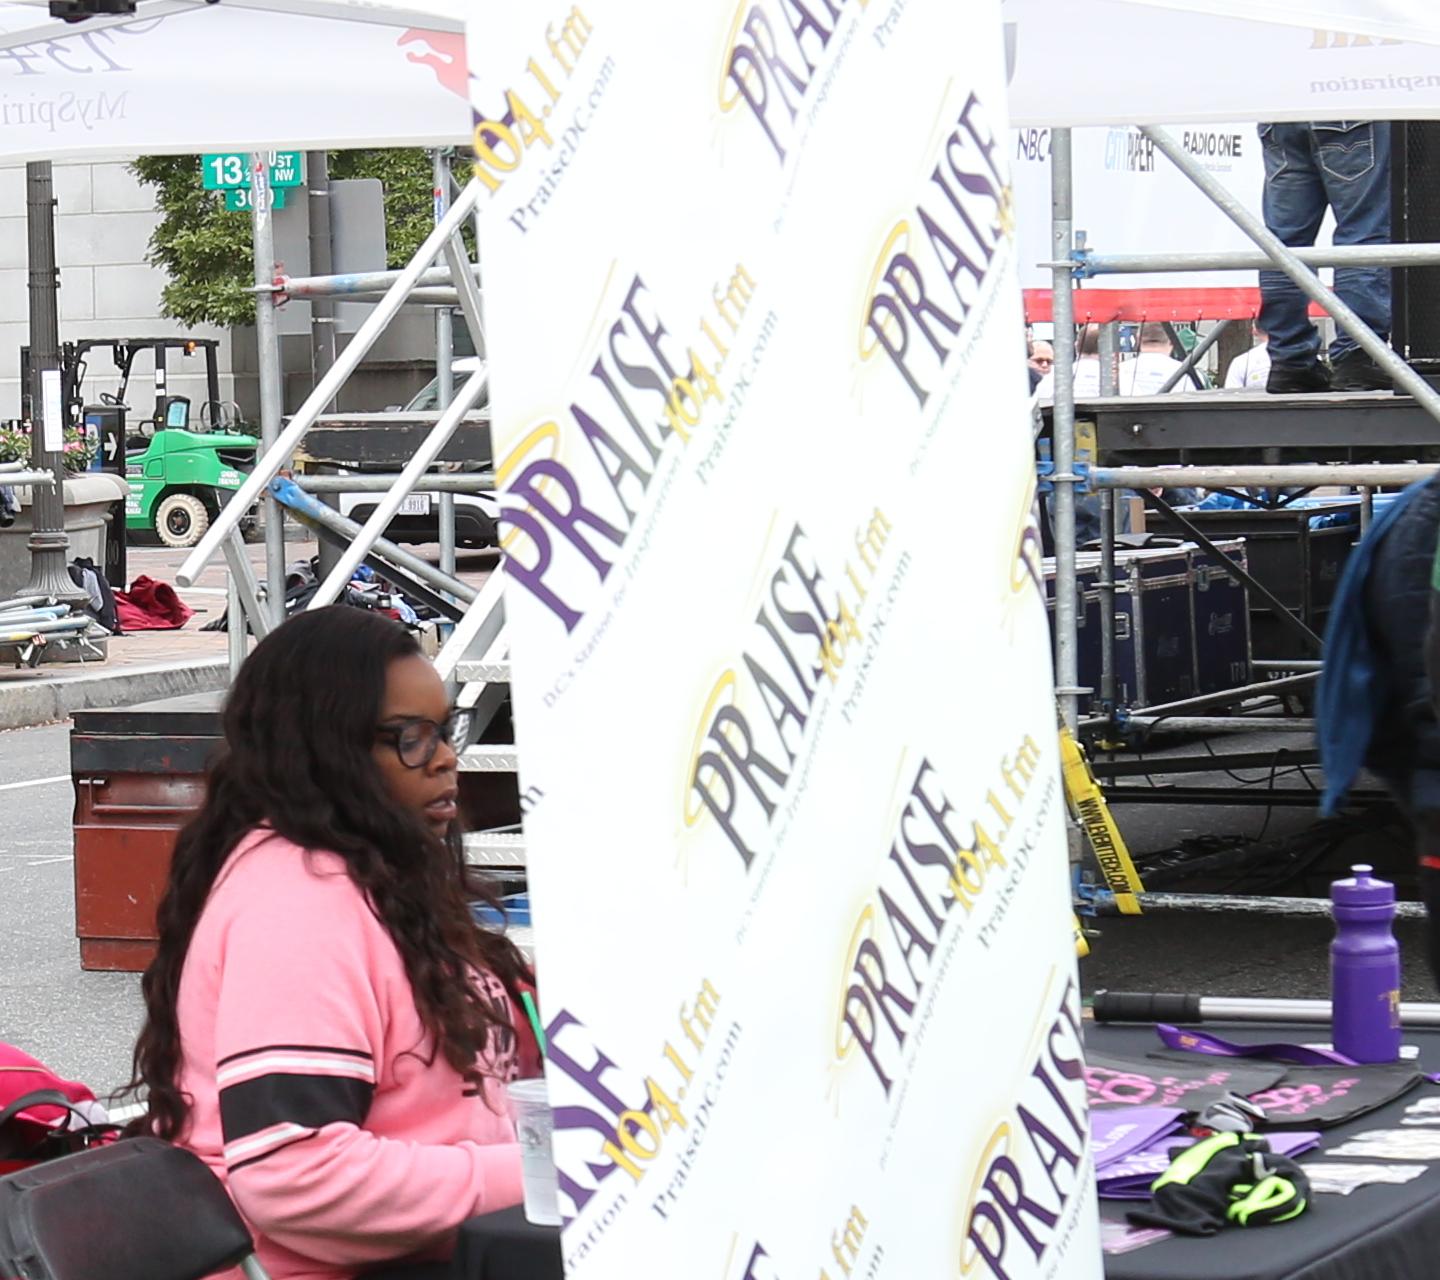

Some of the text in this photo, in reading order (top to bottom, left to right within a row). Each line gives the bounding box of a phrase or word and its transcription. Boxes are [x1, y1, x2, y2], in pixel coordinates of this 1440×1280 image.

[547, 6, 593, 73] fm
[275, 169, 295, 182] NW
[508, 56, 615, 235] PraiseDC.com
[664, 265, 756, 443] 104.1 fm
[694, 310, 778, 486] PraiseDC.com
[499, 271, 682, 637] PRAISE
[856, 508, 892, 572] fm
[693, 524, 830, 870] PRAISE
[840, 550, 912, 725] PraiseDC.com
[948, 736, 1041, 910] 104.1 fm
[977, 775, 1063, 949] PraiseDC.com
[843, 758, 980, 1096] PRAISE
[603, 980, 720, 1180] 104.1 fm
[651, 1021, 742, 1220] PraiseDC.com
[832, 1207, 867, 1273] fm
